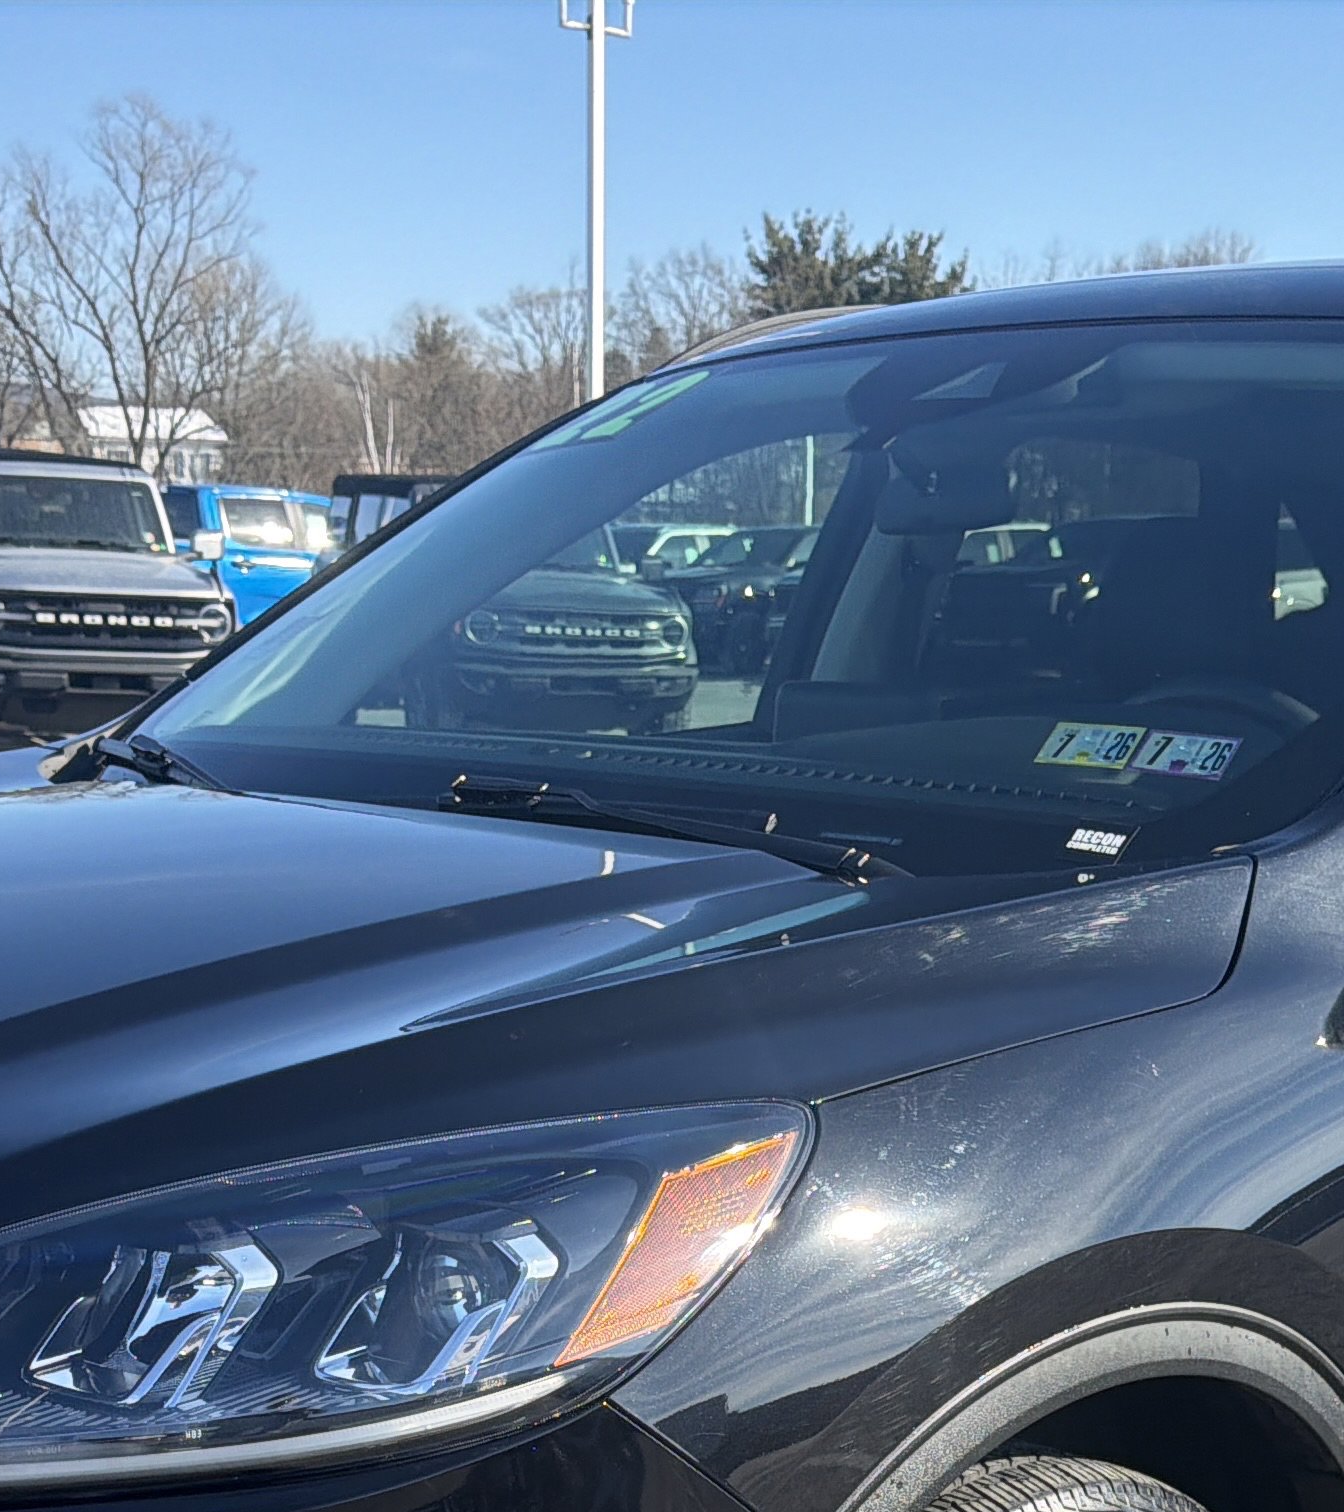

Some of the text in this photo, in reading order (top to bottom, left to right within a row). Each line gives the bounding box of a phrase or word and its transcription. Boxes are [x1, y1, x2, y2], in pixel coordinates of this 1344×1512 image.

[35, 612, 174, 628] BRONCO
[525, 625, 641, 638] BRONCO
[1103, 732, 1138, 761] 26
[1199, 741, 1234, 772] 26
[1071, 828, 1127, 848] RECON
